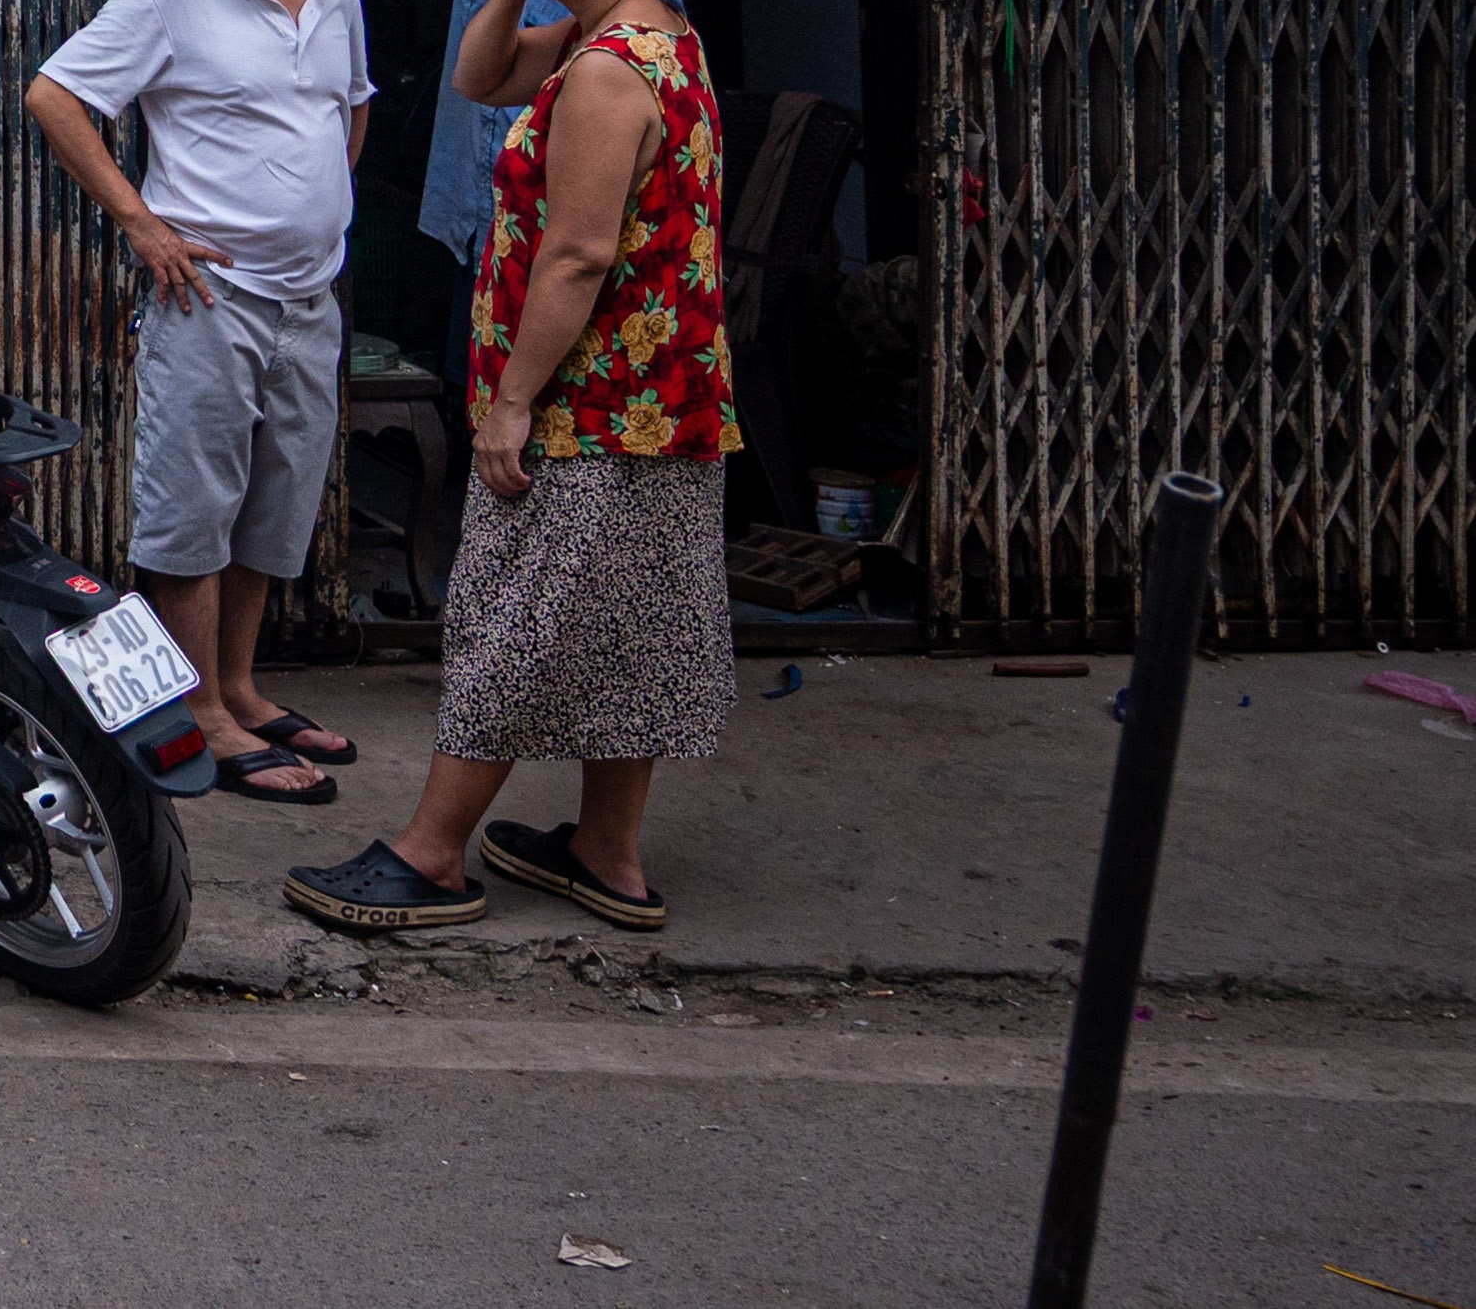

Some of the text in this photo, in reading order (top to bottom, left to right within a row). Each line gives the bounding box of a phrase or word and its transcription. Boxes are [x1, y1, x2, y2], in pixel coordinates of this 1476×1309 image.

[65, 607, 149, 677] 29-AD
[87, 644, 189, 722] 606.22
[340, 905, 410, 925] crocs
